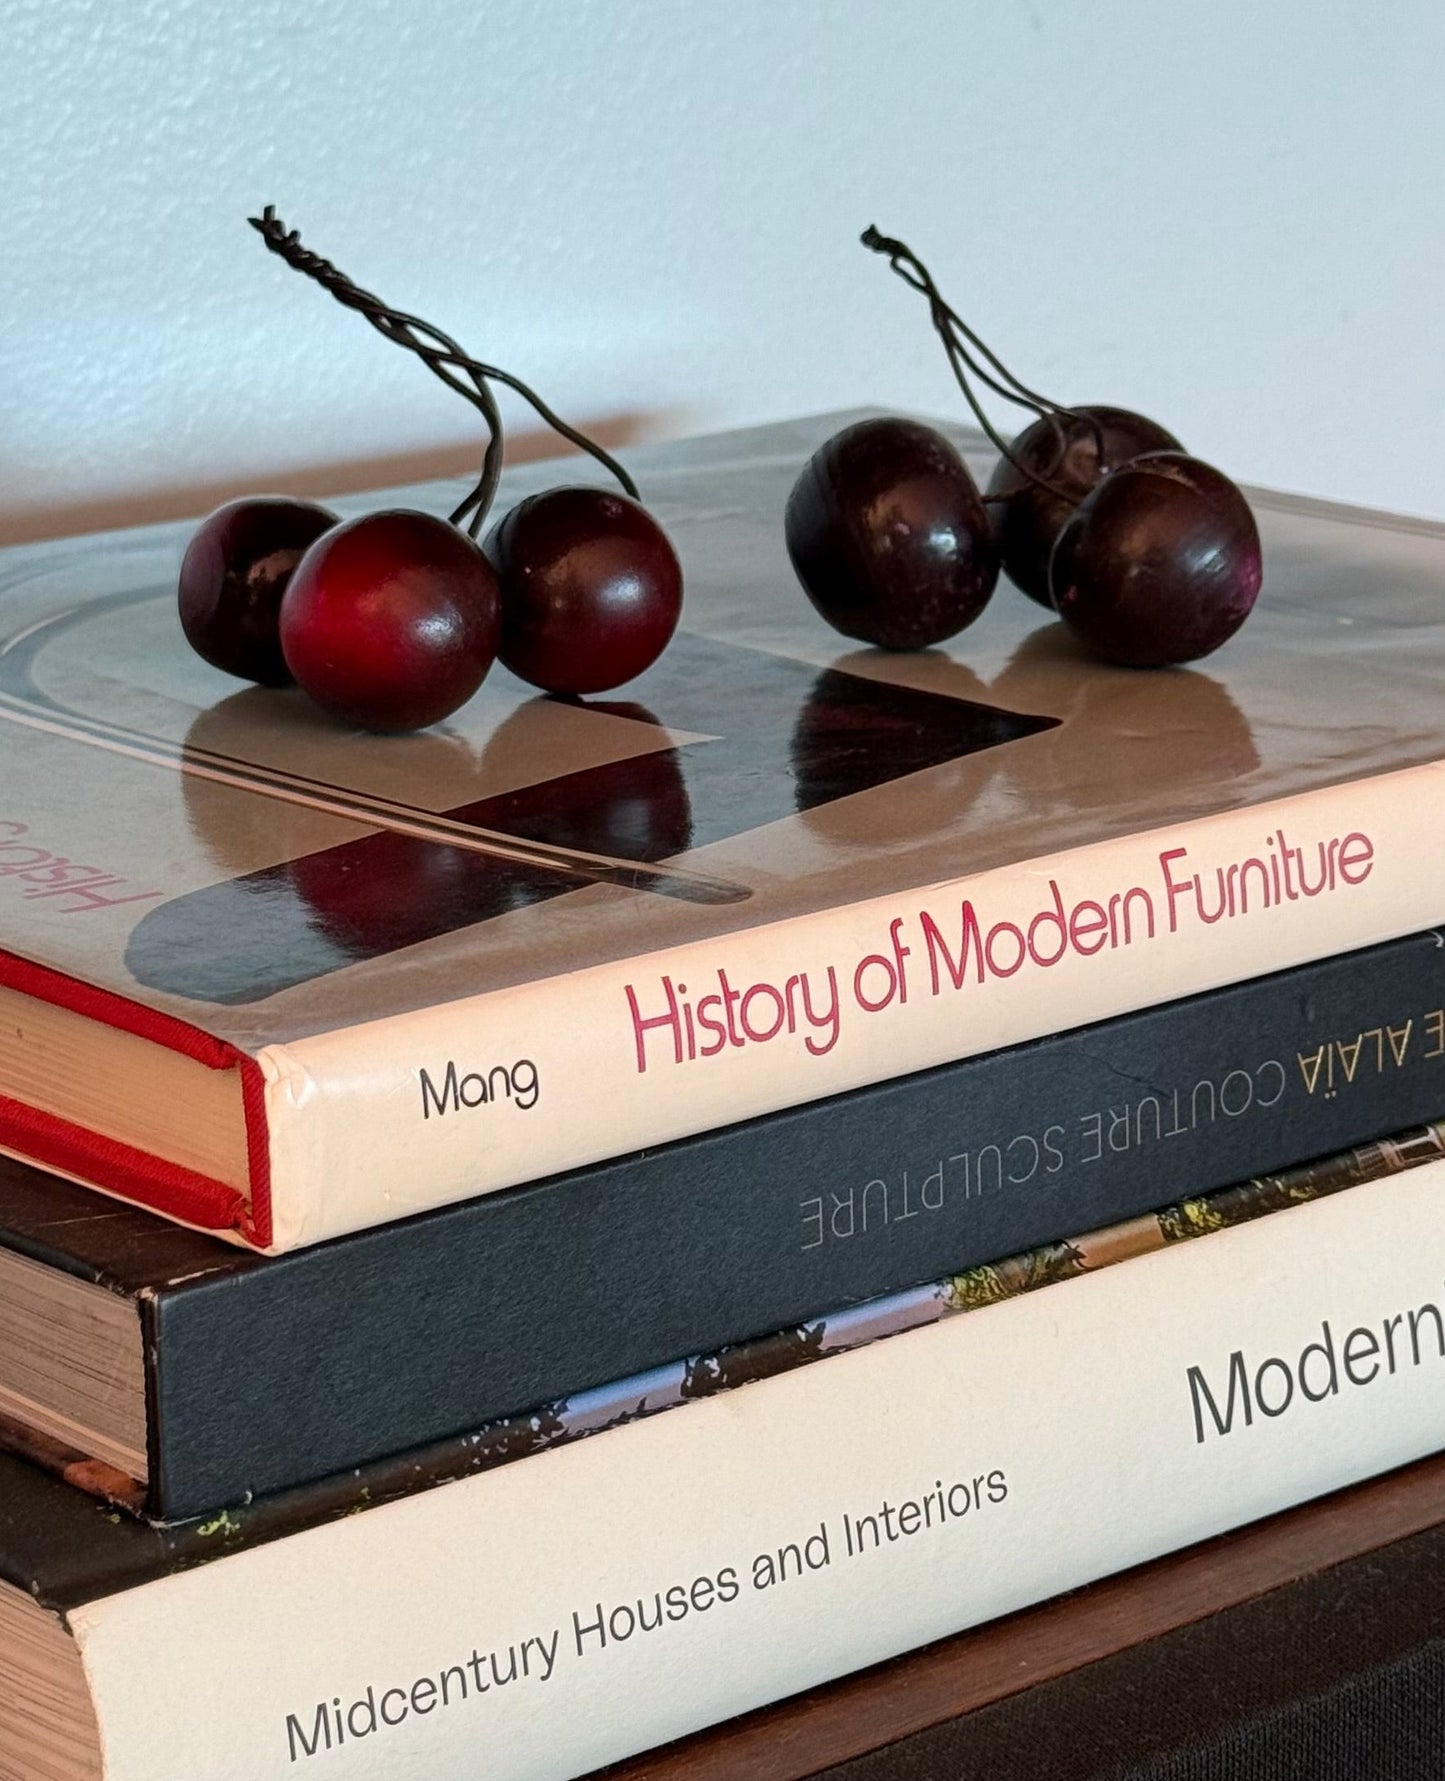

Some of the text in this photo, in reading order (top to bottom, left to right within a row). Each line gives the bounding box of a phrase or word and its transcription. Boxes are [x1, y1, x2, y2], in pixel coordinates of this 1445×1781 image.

[624, 829, 1375, 1074] History of Modern Furniture
[418, 1058, 540, 1121] Mang
[1079, 1059, 1286, 1163] COUTURE
[1296, 1018, 1414, 1100] ALAÏA
[799, 1125, 1066, 1251] SCULPTURE
[1185, 1281, 1445, 1444] Modern
[285, 1469, 1008, 1763] Midcentury Houses and Interiors
